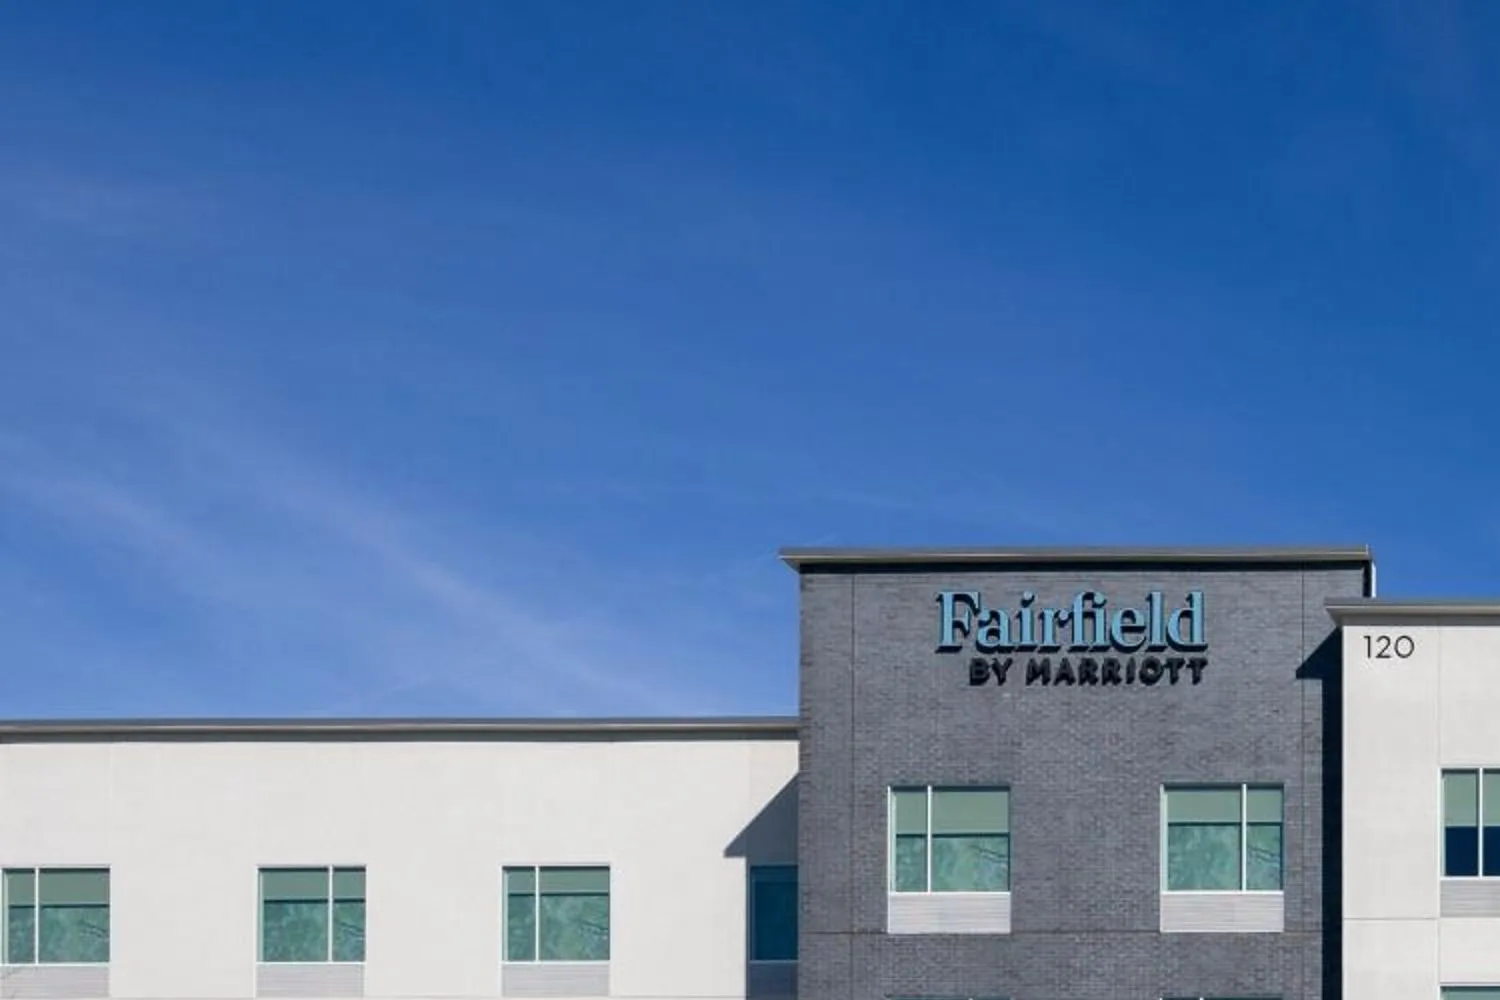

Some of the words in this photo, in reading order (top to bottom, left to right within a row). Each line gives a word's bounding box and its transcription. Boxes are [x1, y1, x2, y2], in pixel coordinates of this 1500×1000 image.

[936, 591, 1208, 652] Fairfield
[1363, 635, 1415, 659] 120
[969, 657, 1013, 686] BY
[1026, 657, 1208, 686] MARRIOTT
